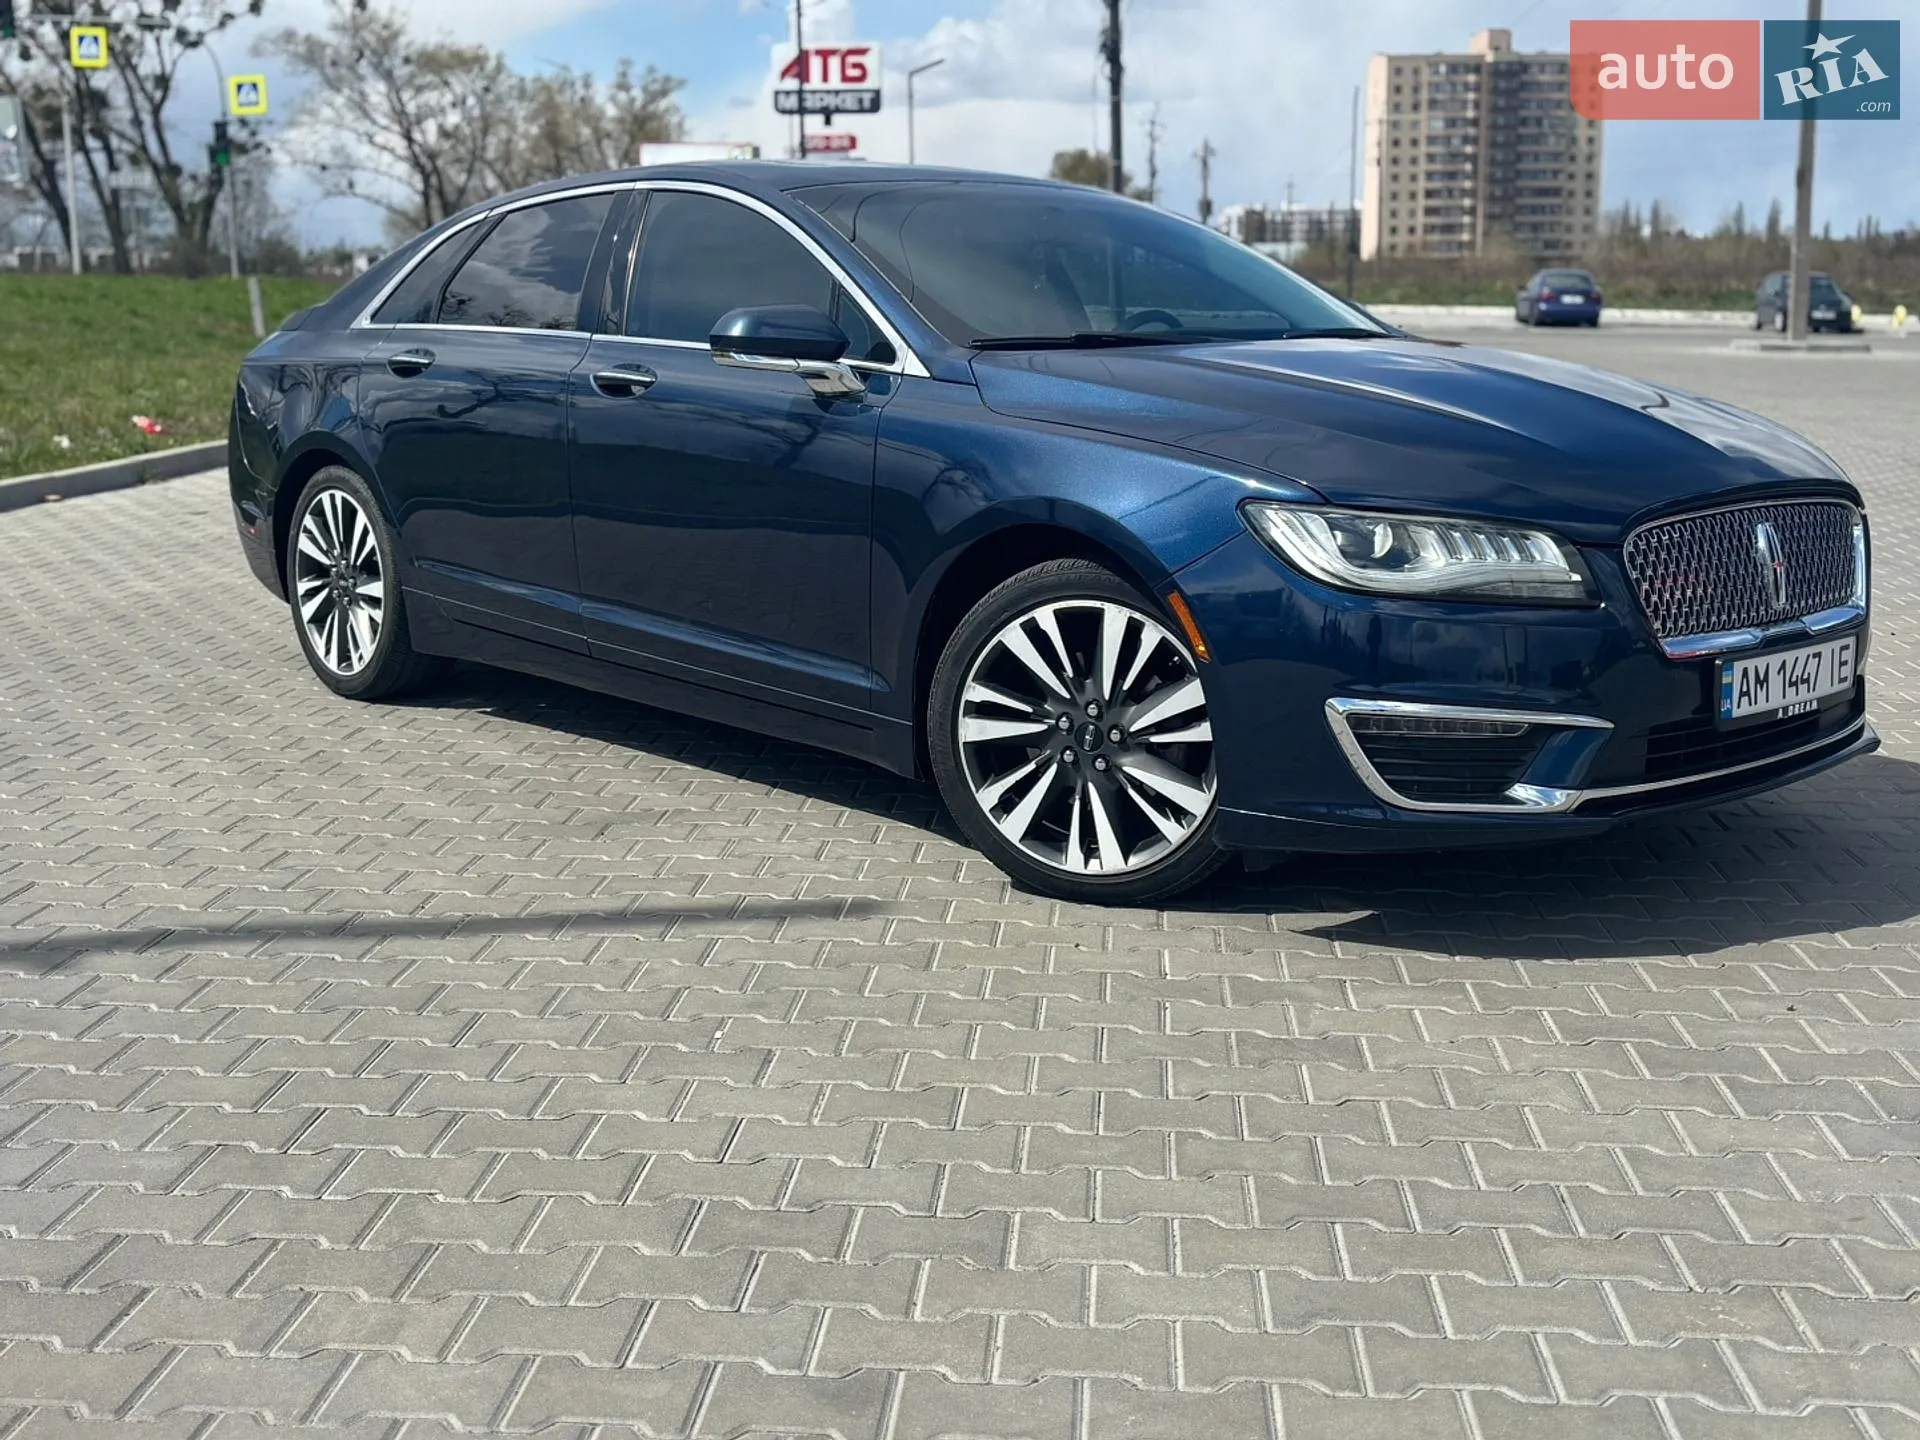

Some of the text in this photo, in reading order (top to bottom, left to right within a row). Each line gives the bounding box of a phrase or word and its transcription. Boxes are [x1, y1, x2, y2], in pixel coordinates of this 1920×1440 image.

[780, 47, 872, 84] АТБ
[1736, 643, 1851, 710] AM 1447 IE
[1720, 698, 1731, 711] UA
